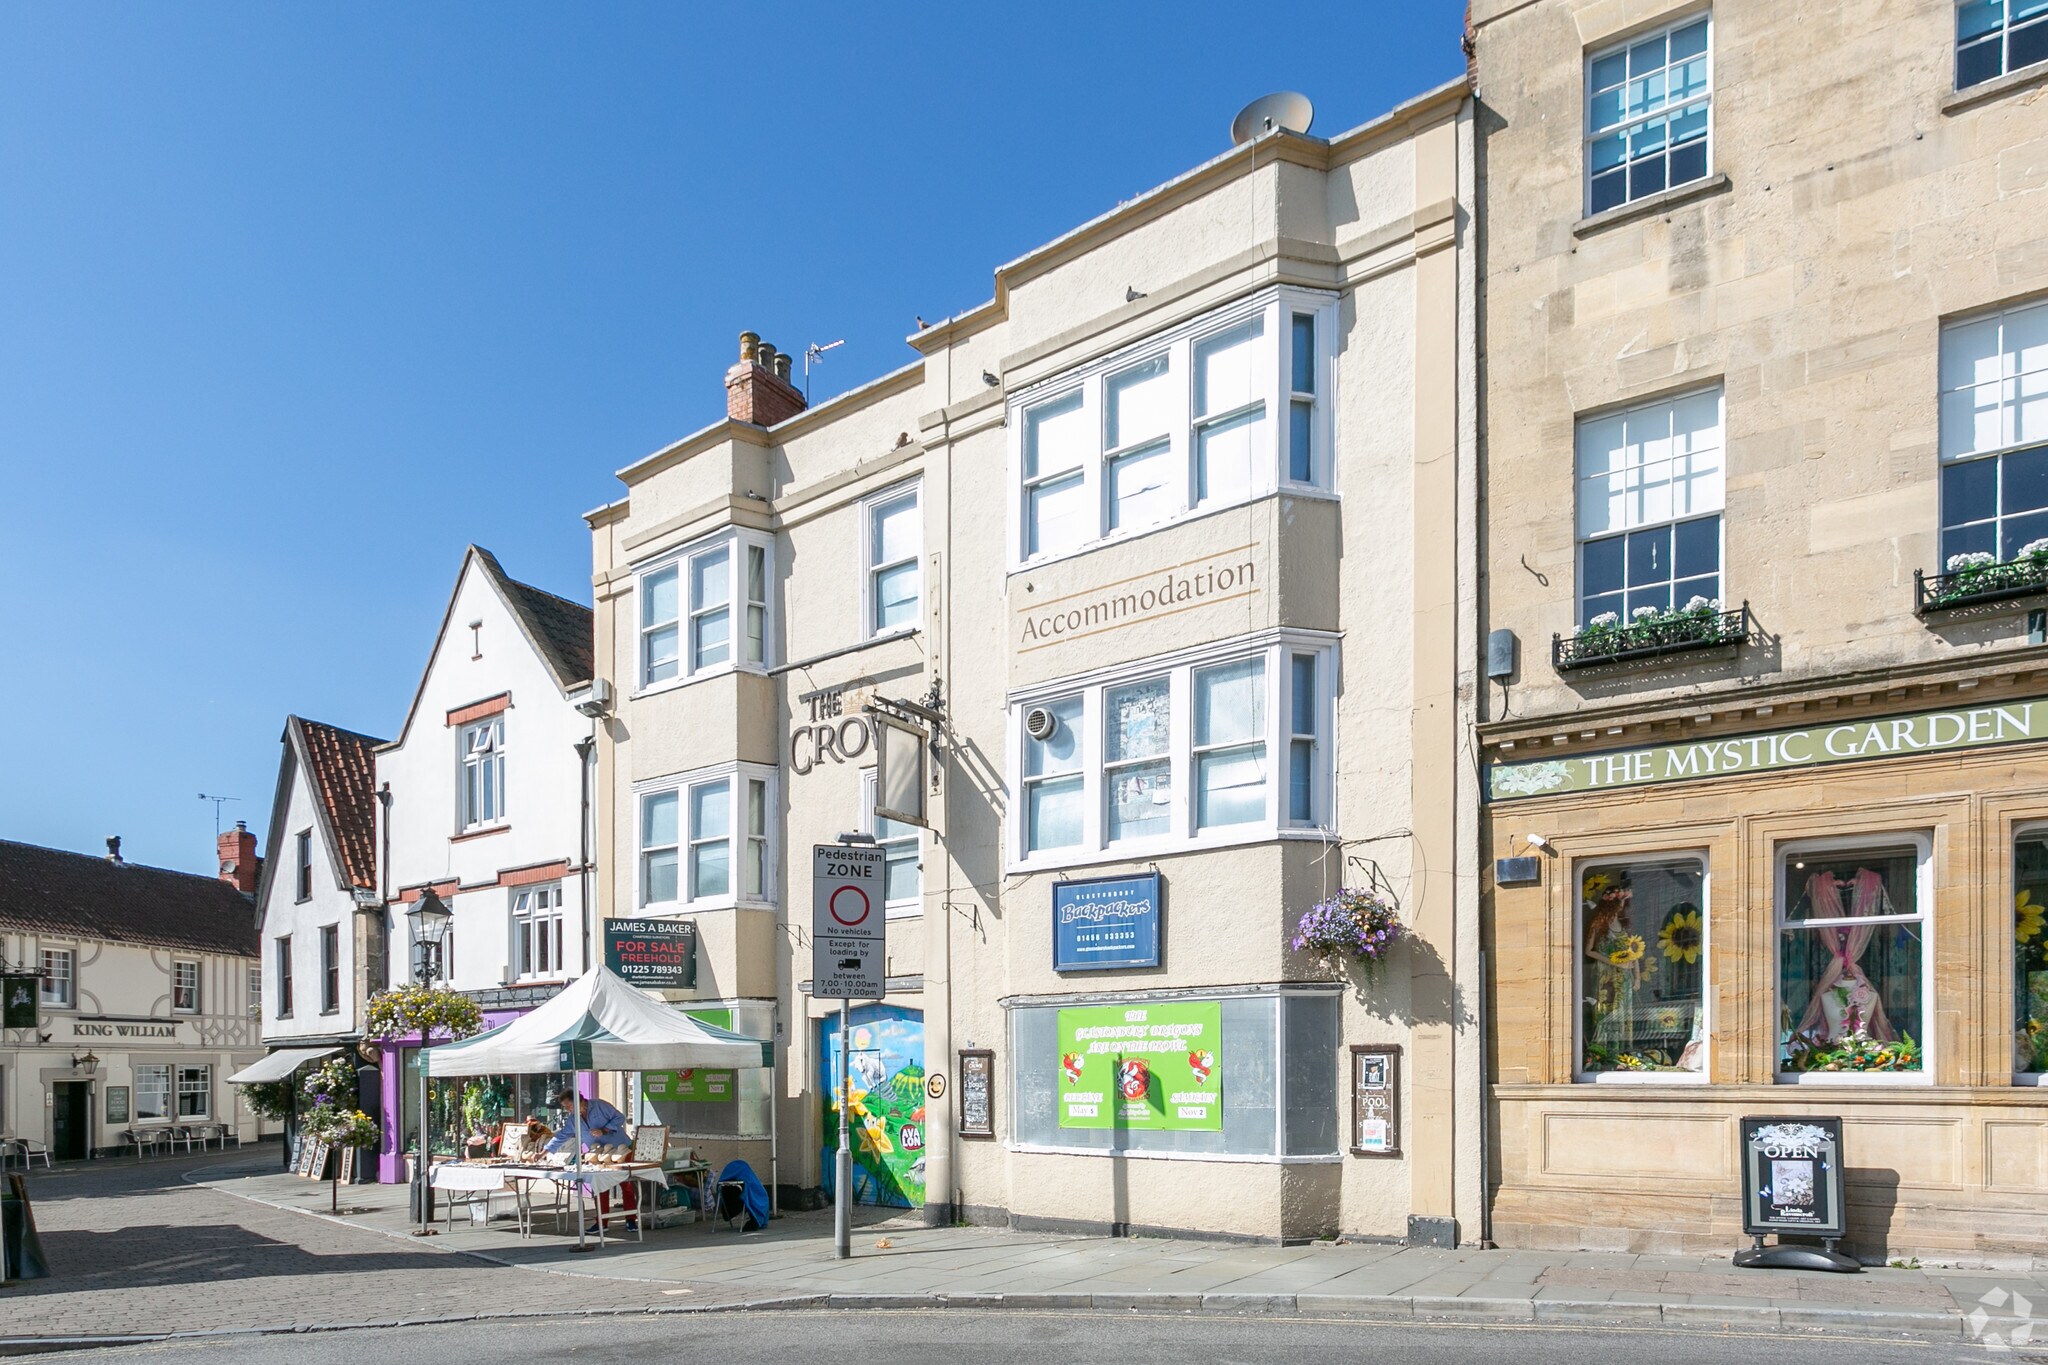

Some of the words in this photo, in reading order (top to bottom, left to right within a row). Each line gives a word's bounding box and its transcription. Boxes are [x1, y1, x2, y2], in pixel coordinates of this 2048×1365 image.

[1021, 561, 1255, 643] Accommodation
[806, 691, 842, 723] THE
[789, 713, 879, 776] CRO
[1583, 751, 1654, 787] THE
[1665, 731, 1811, 777] MYSTIC
[1825, 704, 2032, 757] GARDEN
[817, 848, 882, 862] Pedestrian
[827, 863, 872, 877] ZONE
[1061, 899, 1151, 923] Backpackers
[610, 922, 645, 932] JAMES
[648, 924, 656, 932] A
[658, 924, 691, 933] BAKER
[841, 927, 872, 935] vehicles
[616, 941, 646, 952] FOR
[650, 942, 685, 953] SALE
[829, 940, 855, 948] Except
[621, 953, 681, 963] FREEHOLD
[830, 948, 857, 957] loading
[860, 949, 869, 957] by
[621, 965, 649, 973] 01225
[651, 966, 683, 974] 789343
[833, 972, 866, 980] between
[844, 980, 878, 988] 10.00am
[847, 989, 877, 997] 7.00pm
[73, 1024, 113, 1036] KING
[116, 1025, 176, 1037] WILLIAM
[1150, 1024, 1203, 1038] DRAGONS
[1072, 1106, 1087, 1115] May
[1181, 1107, 1197, 1116] Nov
[902, 1127, 920, 1138] AVA
[902, 1136, 921, 1147] LON
[1764, 1145, 1818, 1159] OPEN
